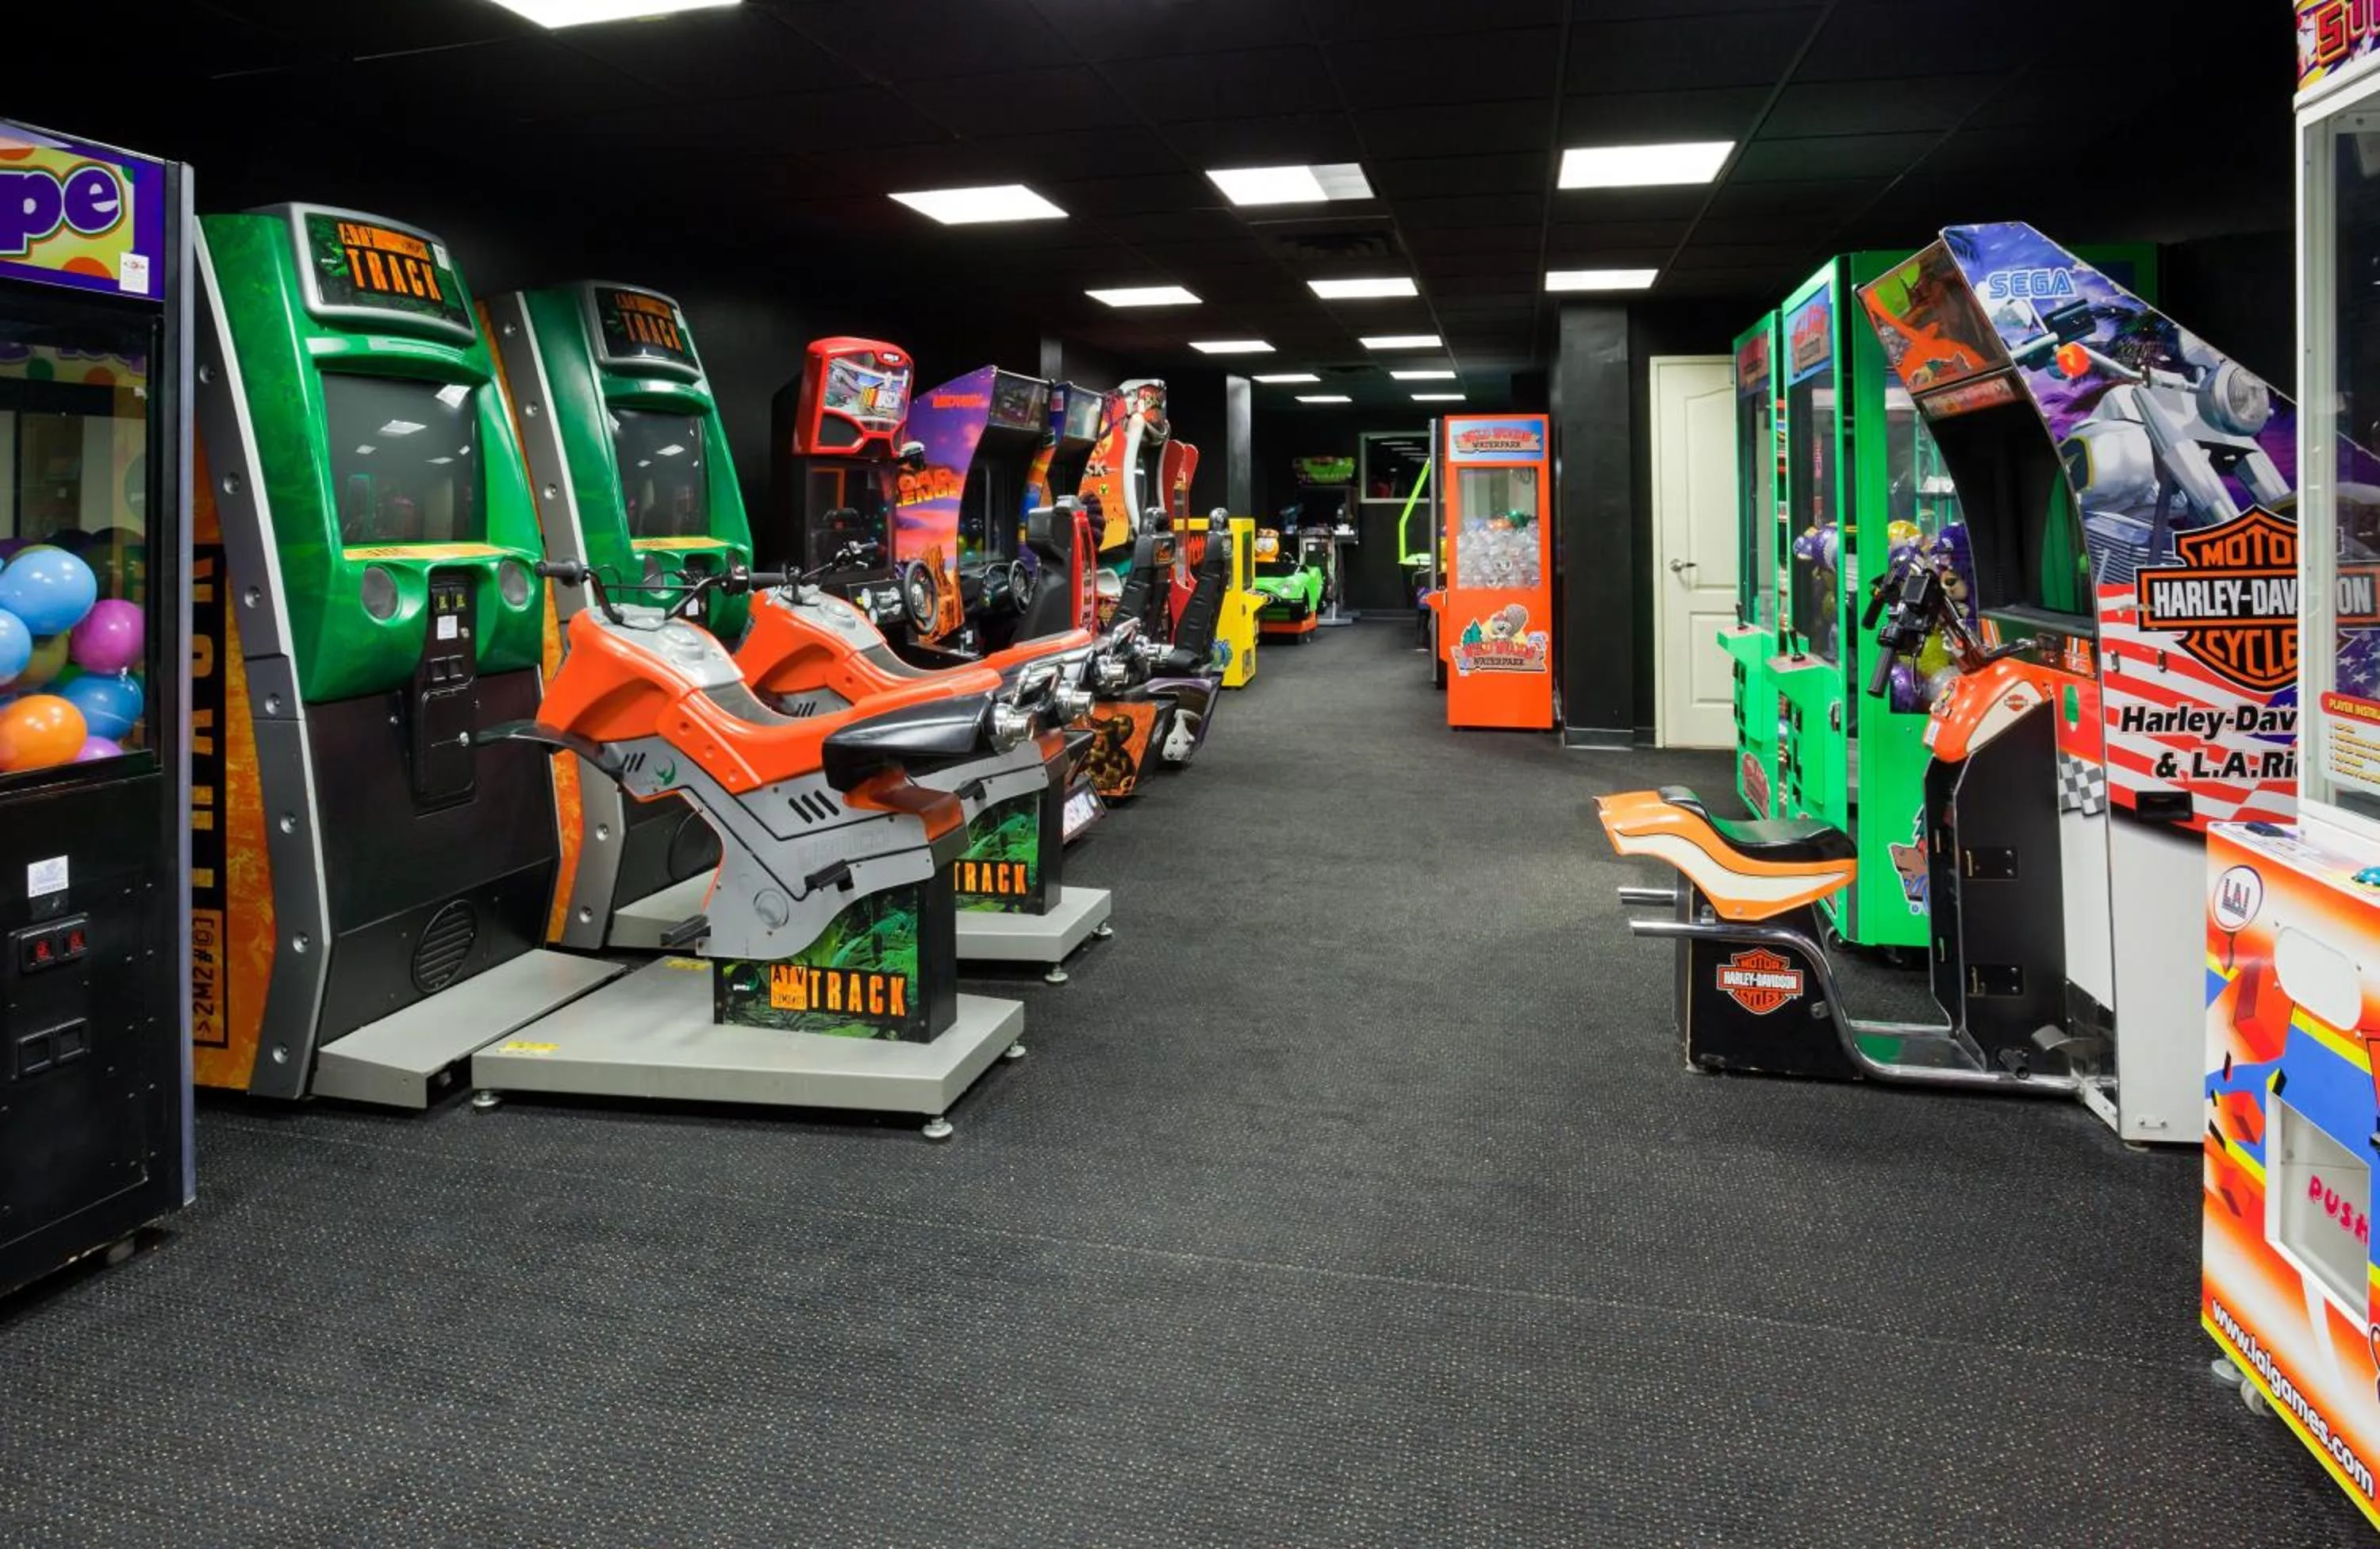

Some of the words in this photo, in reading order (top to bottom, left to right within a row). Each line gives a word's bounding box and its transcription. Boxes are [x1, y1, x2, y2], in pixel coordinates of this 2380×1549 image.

[346, 248, 443, 302] TRACK
[1989, 268, 2077, 299] SEGA
[2201, 524, 2298, 567] MOTO
[2155, 752, 2177, 778] &
[773, 966, 804, 985] ATV
[809, 969, 905, 1017] TRACK
[1724, 971, 1797, 990] HARLEY-DAVIDSON
[2308, 1174, 2368, 1245] PUSH
[2211, 1297, 2374, 1501] www.laigames.com
